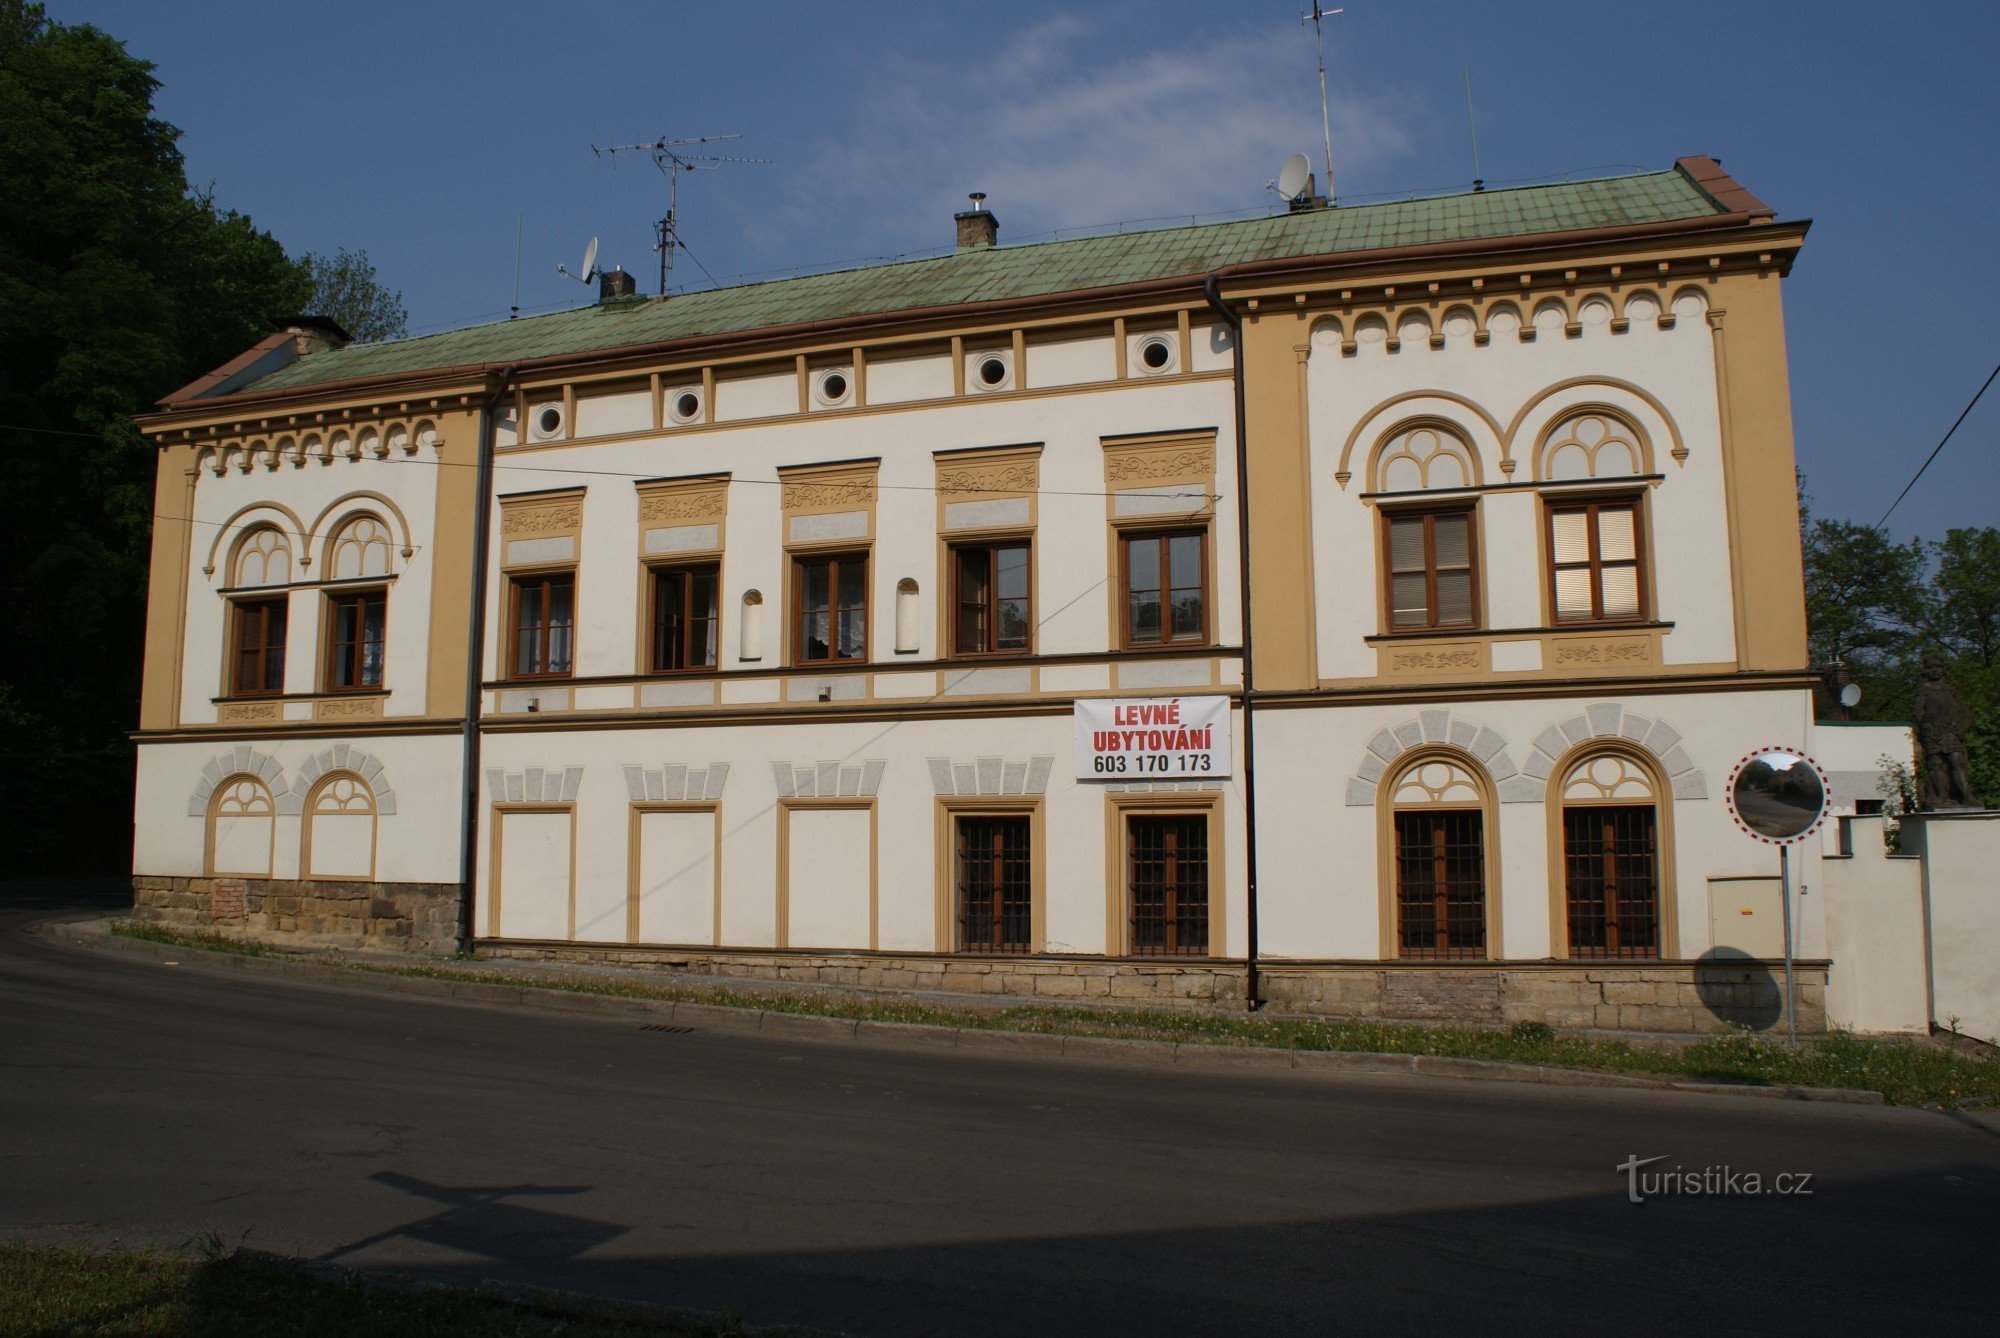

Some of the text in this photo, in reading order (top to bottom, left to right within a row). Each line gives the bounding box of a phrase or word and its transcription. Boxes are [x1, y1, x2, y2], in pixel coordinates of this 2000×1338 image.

[1115, 699, 1180, 726] LEVNÉ
[1093, 723, 1213, 752] UBYTOVÁNÍ
[1094, 754, 1211, 773] 603 170 173
[1800, 885, 1808, 895] 2
